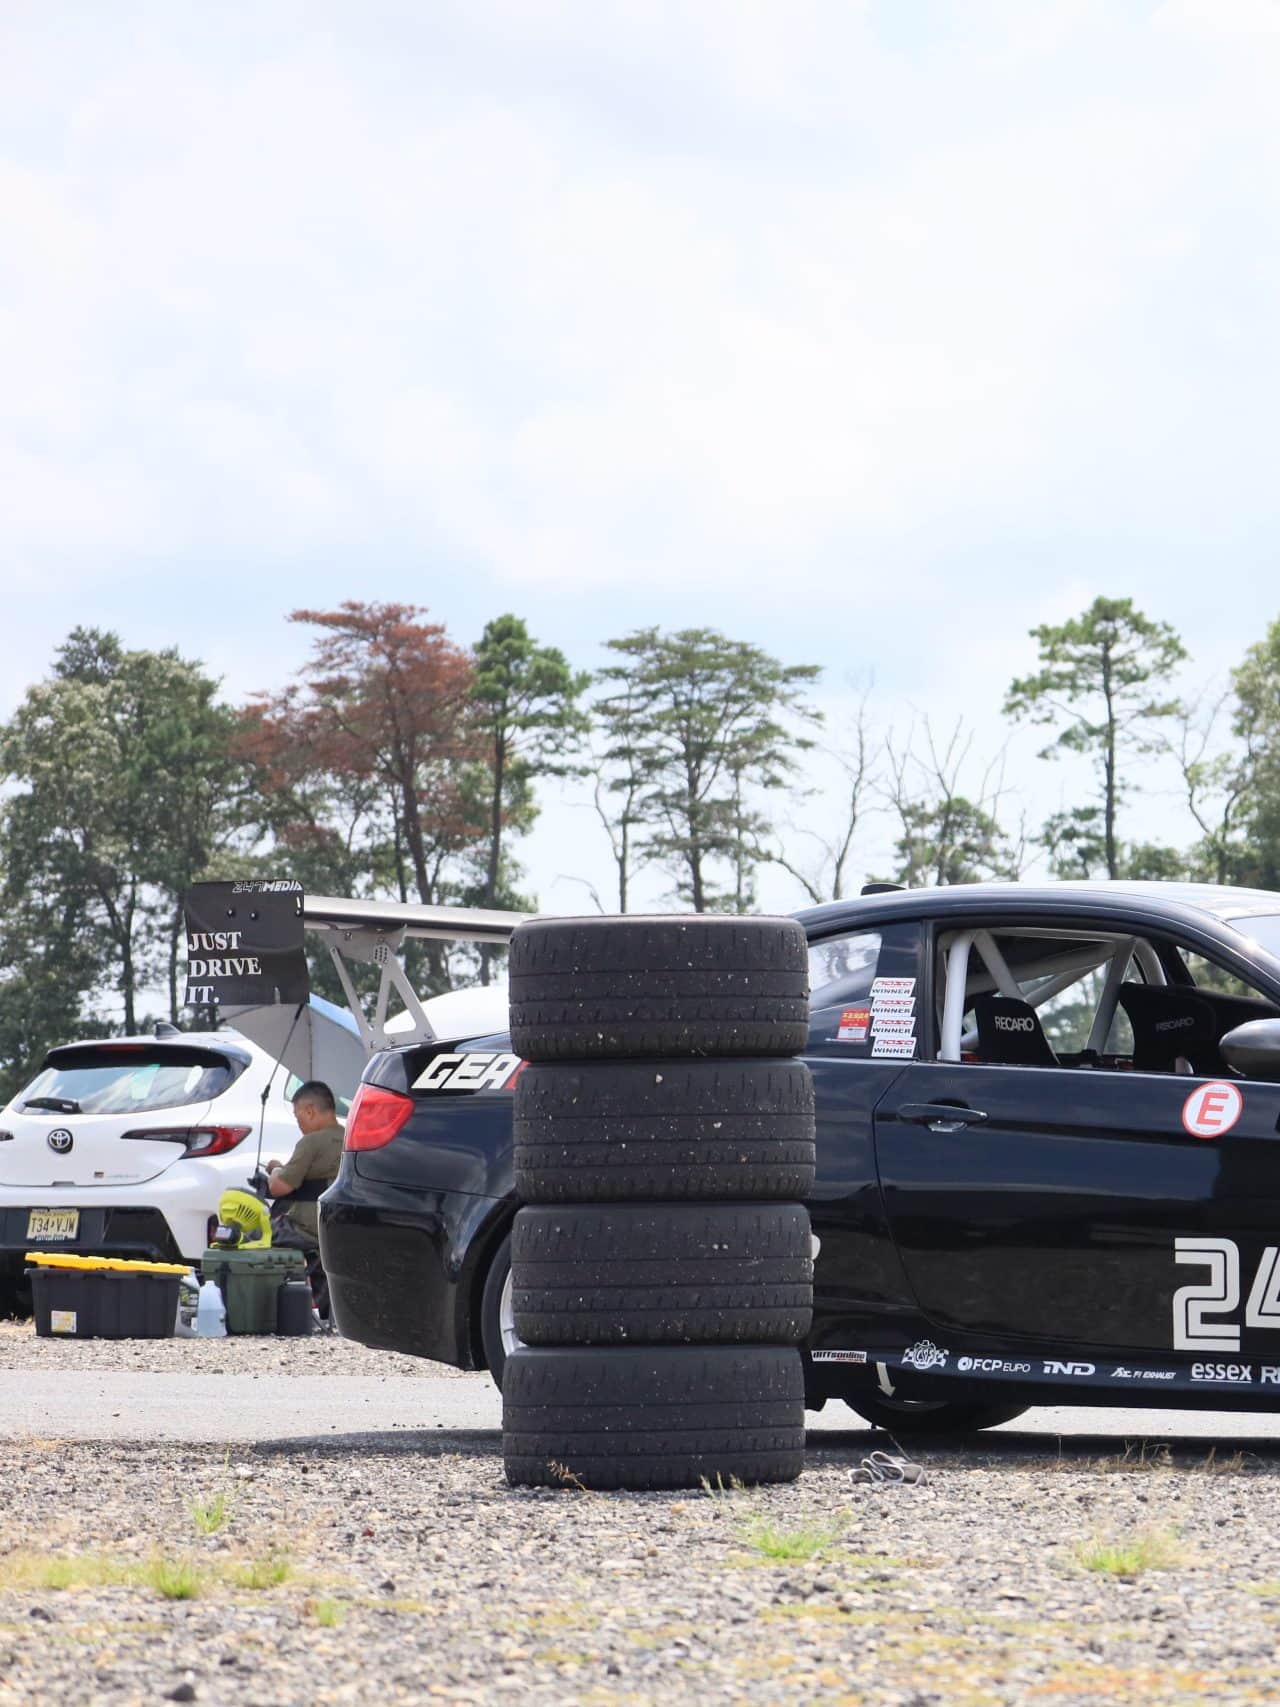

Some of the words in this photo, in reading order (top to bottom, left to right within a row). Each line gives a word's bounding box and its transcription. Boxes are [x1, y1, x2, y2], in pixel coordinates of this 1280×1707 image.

[188, 931, 241, 951] JUST
[189, 957, 261, 977] DRIVE
[186, 985, 220, 1004] IT.
[994, 1015, 1034, 1032] RECARO
[1196, 1092, 1229, 1126] E
[972, 1358, 1003, 1372] FCP
[1191, 1361, 1252, 1381] essex
